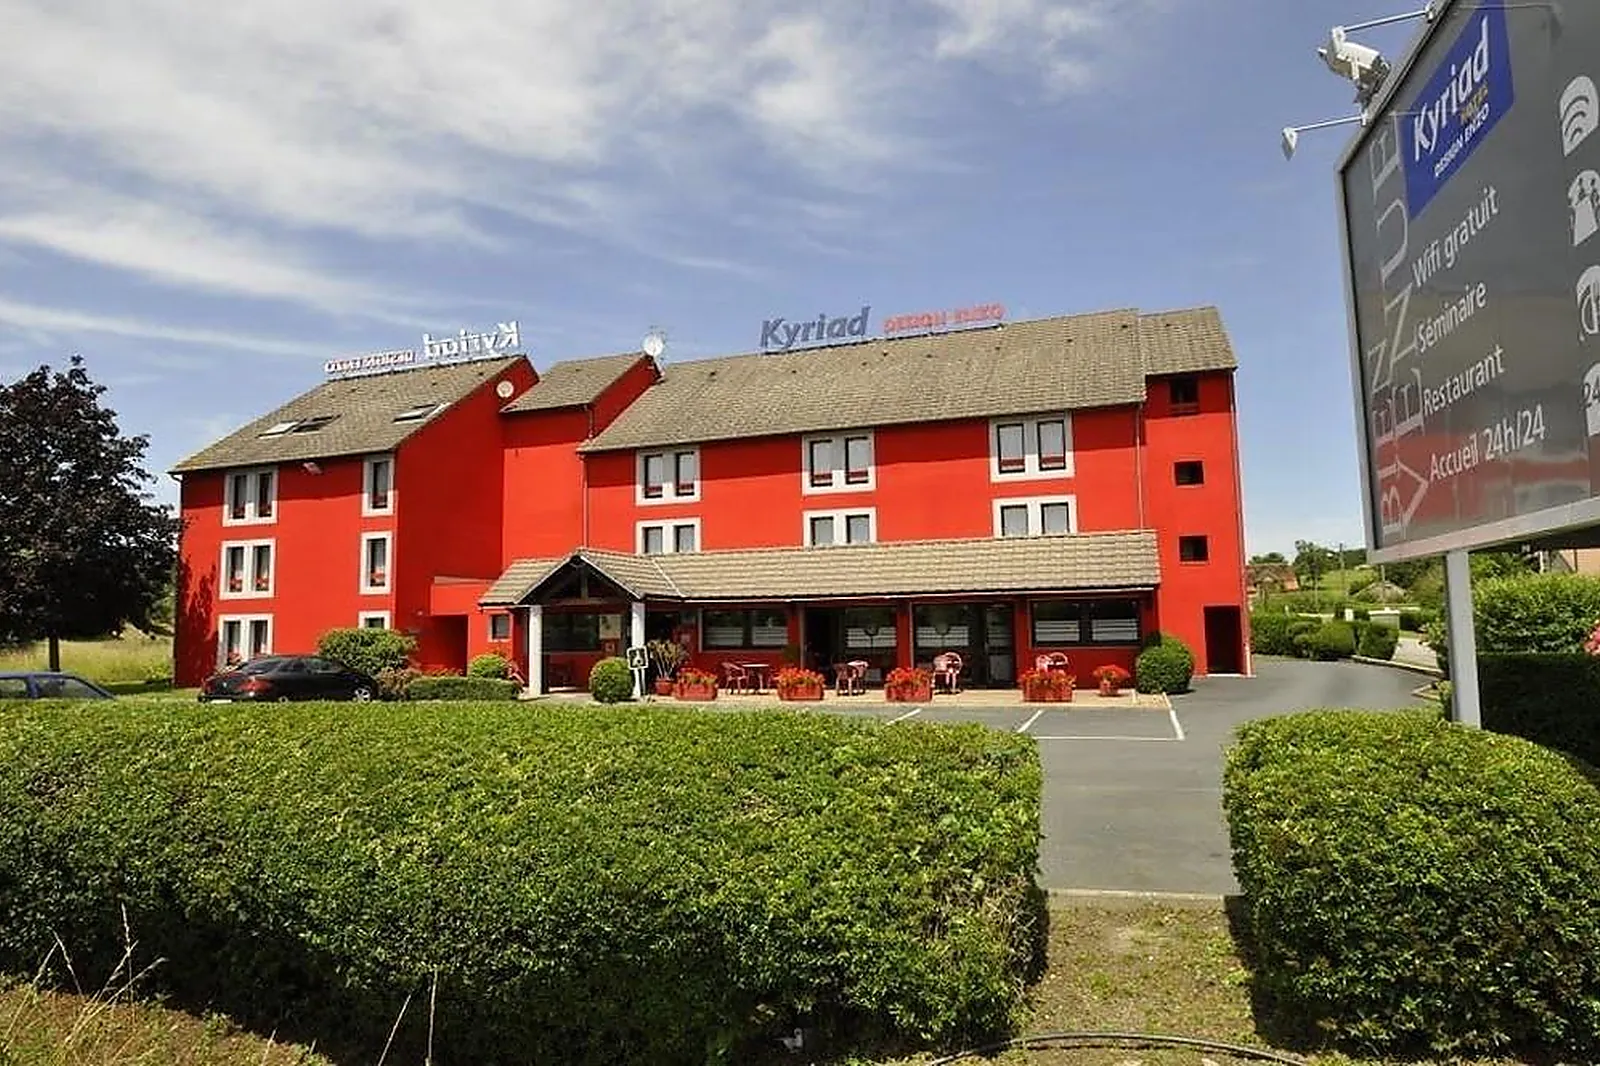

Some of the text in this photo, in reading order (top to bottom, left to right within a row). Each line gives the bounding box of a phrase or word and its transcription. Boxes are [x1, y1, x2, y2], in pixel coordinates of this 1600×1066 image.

[1413, 16, 1489, 162] Kyriad
[1411, 185, 1500, 288] Wifi gratuit
[760, 306, 871, 349] Kyriad
[1417, 281, 1487, 352] Séminaire
[1423, 345, 1505, 416] Restaurant
[1430, 403, 1546, 481] Accueil 24h/24
